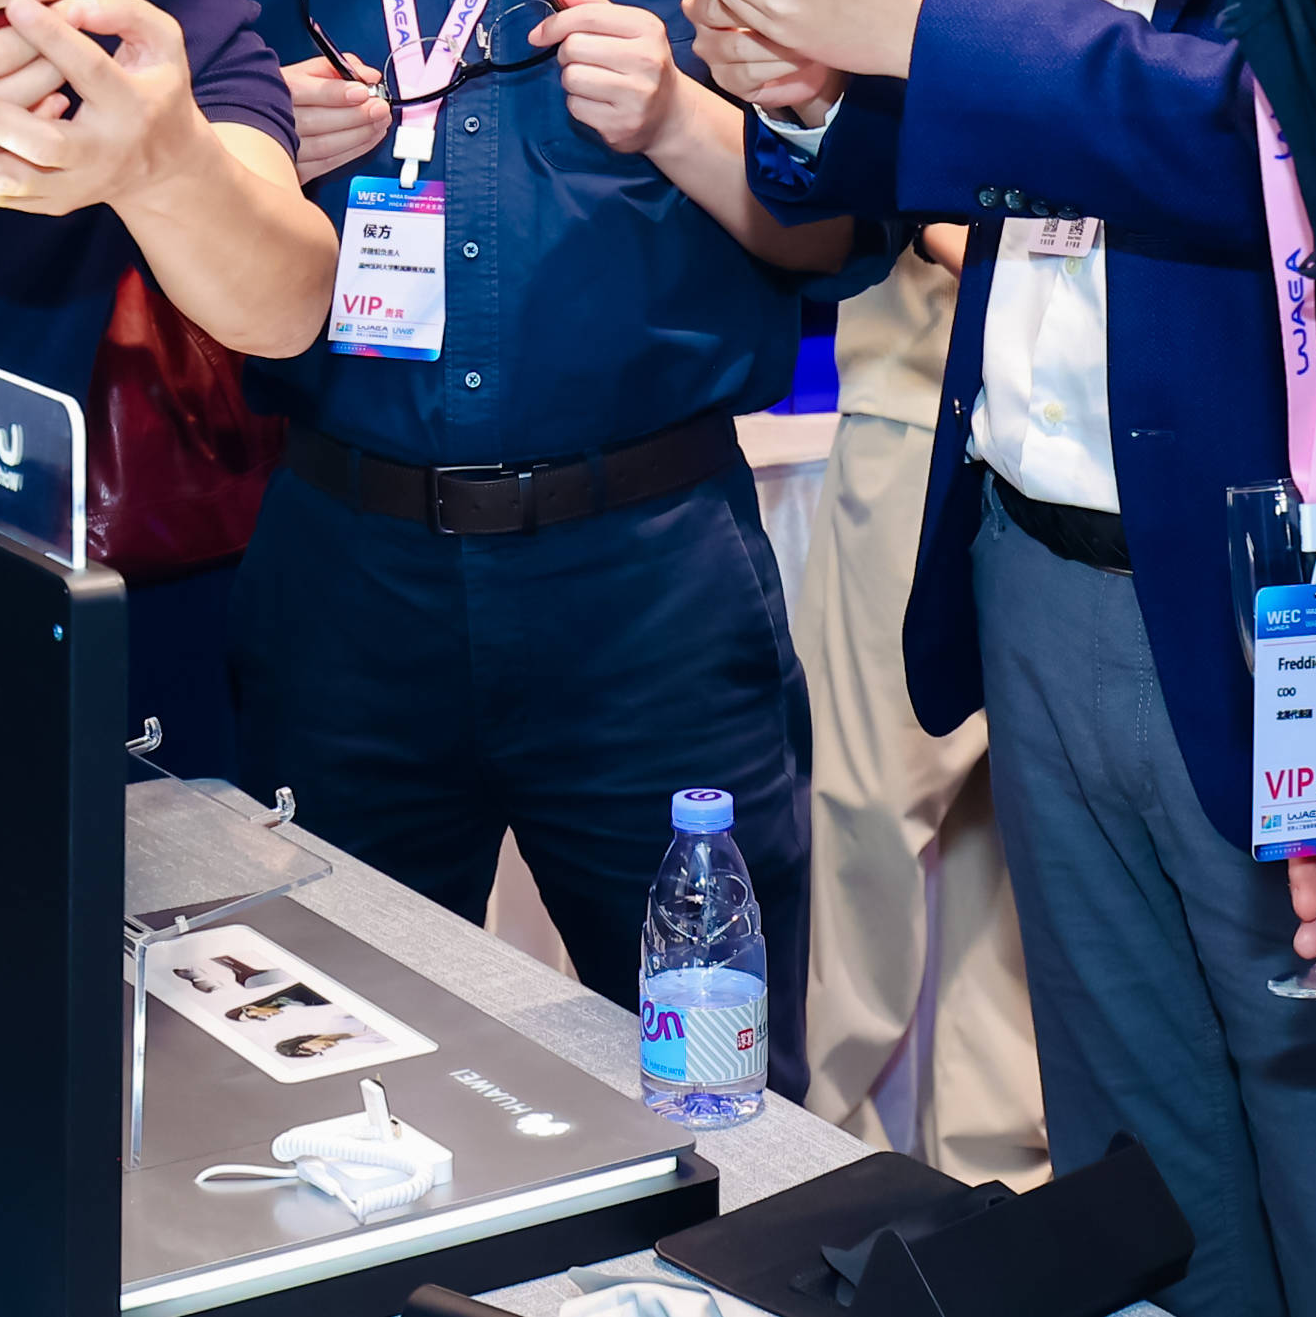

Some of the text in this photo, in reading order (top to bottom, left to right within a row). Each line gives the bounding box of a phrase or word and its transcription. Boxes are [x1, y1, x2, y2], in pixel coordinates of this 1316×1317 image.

[357, 190, 386, 203] WEC
[363, 224, 392, 240] 侯方
[342, 293, 383, 316] VIP
[1285, 248, 1310, 376] WAEA
[1267, 609, 1301, 625] WEC
[1265, 768, 1315, 800] VIP
[448, 1068, 534, 1115] HUAWEI
